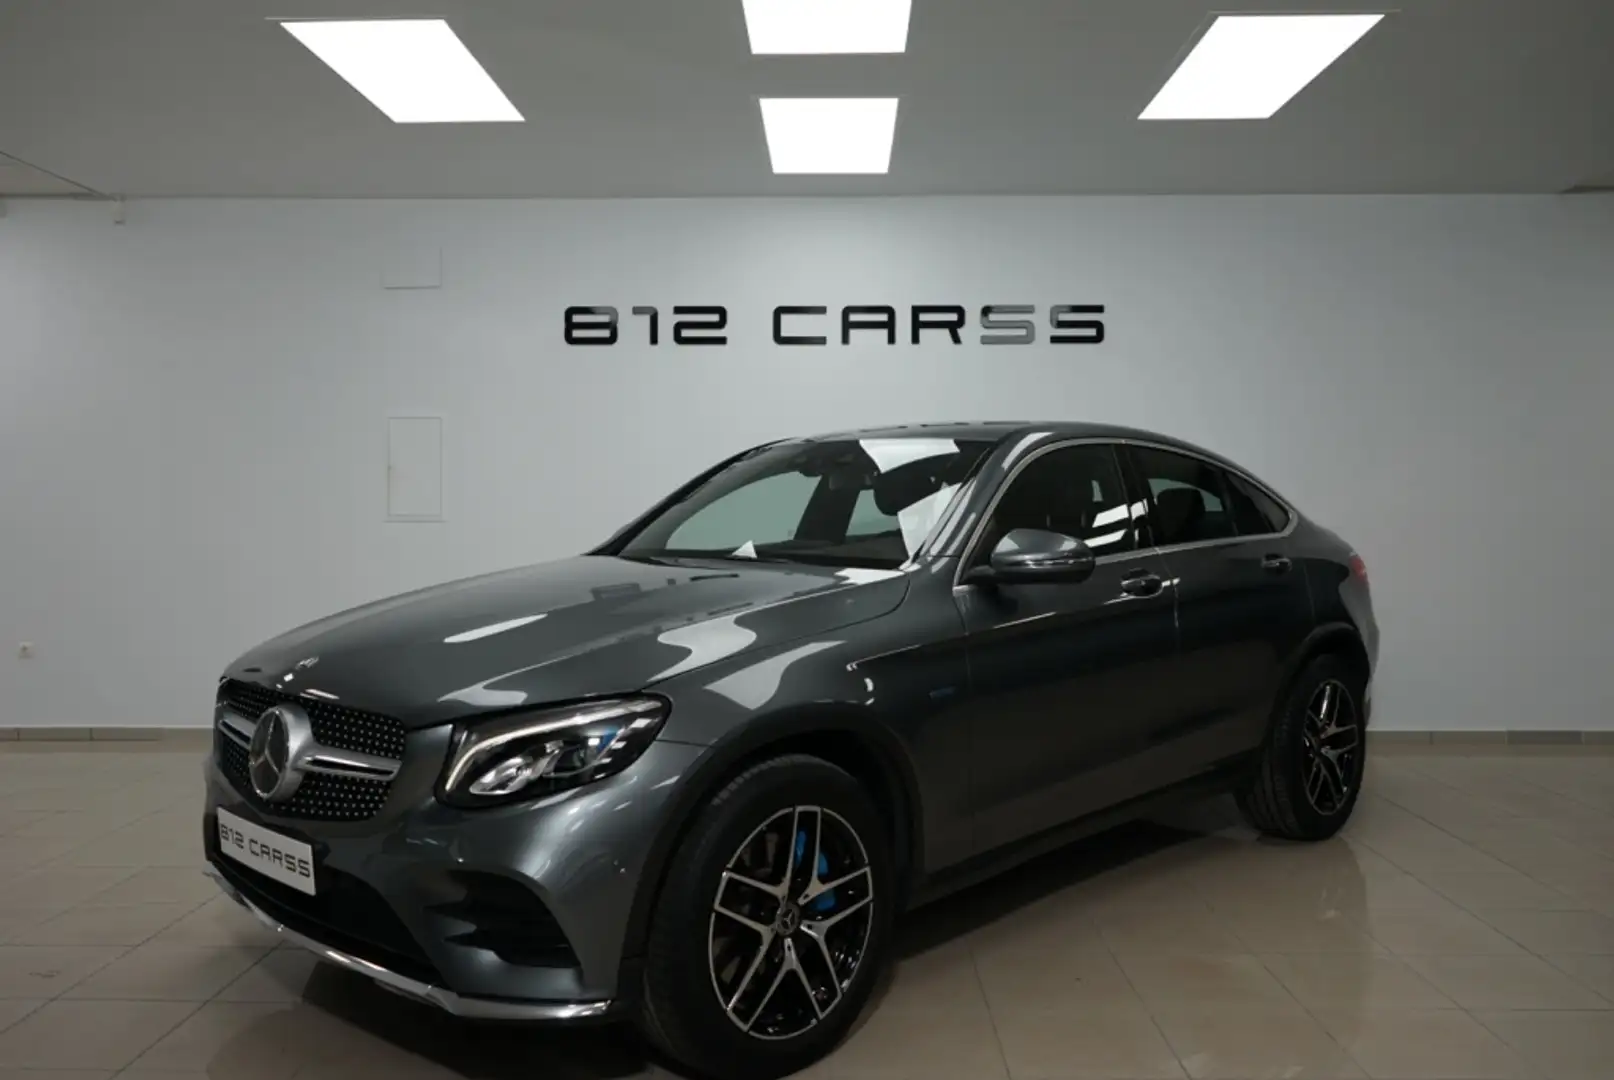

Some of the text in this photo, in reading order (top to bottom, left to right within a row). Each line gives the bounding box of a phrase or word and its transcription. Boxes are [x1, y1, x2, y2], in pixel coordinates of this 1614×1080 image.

[564, 305, 1106, 345] 812 CARSS
[220, 824, 311, 878] 812 CARSS
